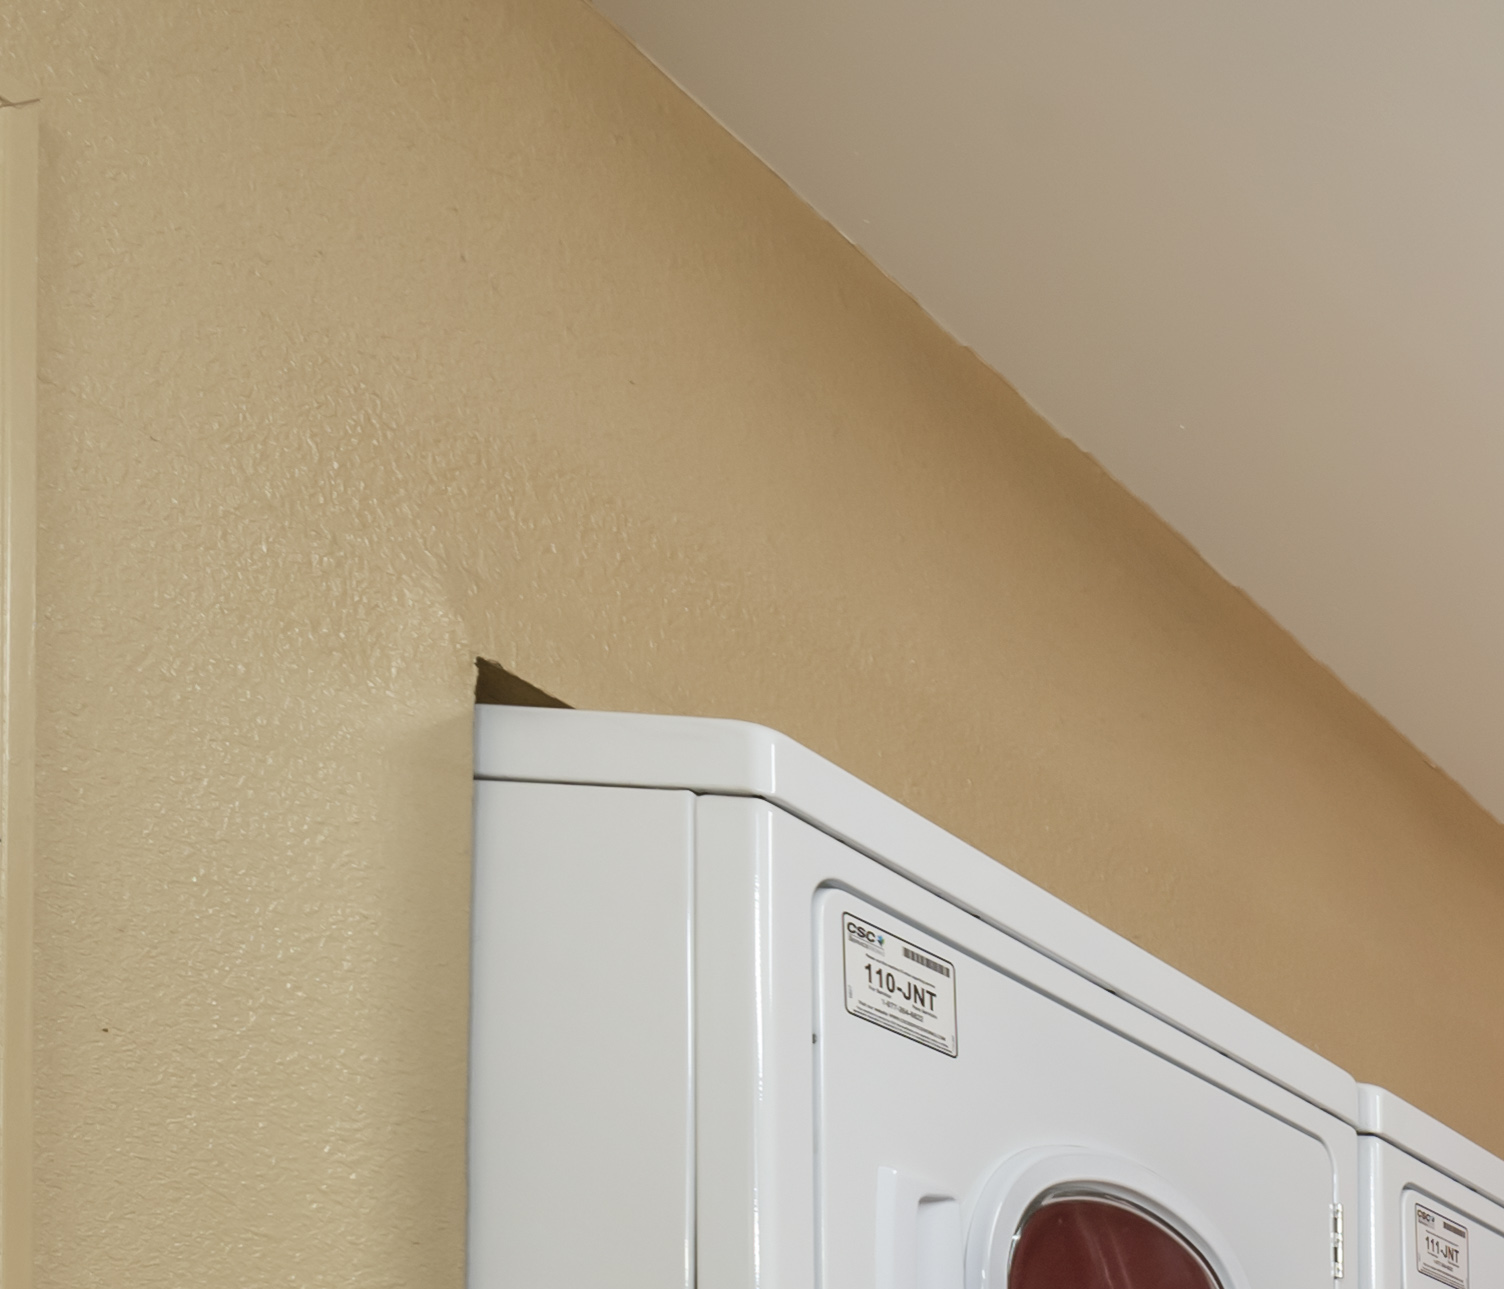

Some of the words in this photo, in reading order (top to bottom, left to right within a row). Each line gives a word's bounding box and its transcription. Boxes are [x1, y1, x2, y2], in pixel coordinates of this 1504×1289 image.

[847, 922, 876, 943] CSC
[865, 963, 937, 1011] 110-JNT
[1424, 1235, 1460, 1264] 111-JNT
